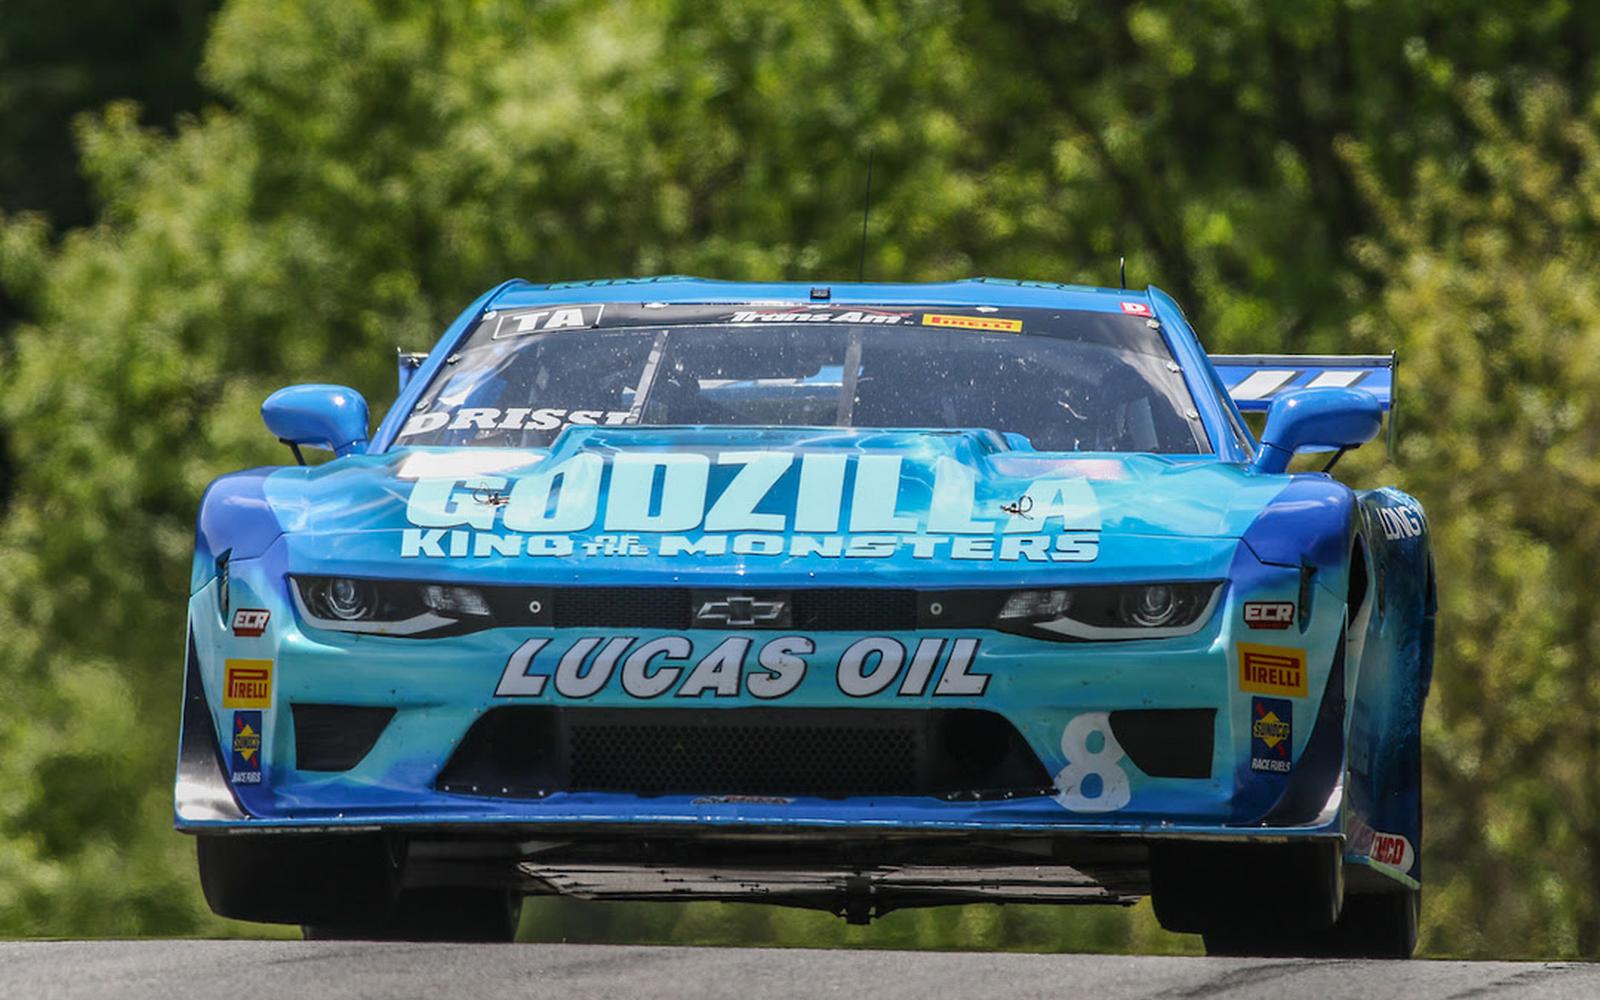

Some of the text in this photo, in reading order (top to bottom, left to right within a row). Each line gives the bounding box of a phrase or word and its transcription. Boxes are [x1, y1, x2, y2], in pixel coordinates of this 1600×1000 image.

[512, 308, 585, 332] TA
[730, 306, 833, 323] Trans
[830, 311, 902, 325] Am
[931, 316, 1013, 331] PIRELLI
[406, 452, 1103, 534] GODZILLA
[401, 528, 574, 558] KING
[657, 532, 1100, 562] MONSTERS
[233, 610, 270, 630] ECR
[1244, 603, 1293, 622] ECR
[228, 668, 269, 699] PIRELLI
[493, 636, 992, 700] LUCAS OIL
[1244, 652, 1301, 688] PIRELLI
[1050, 711, 1132, 813] 8
